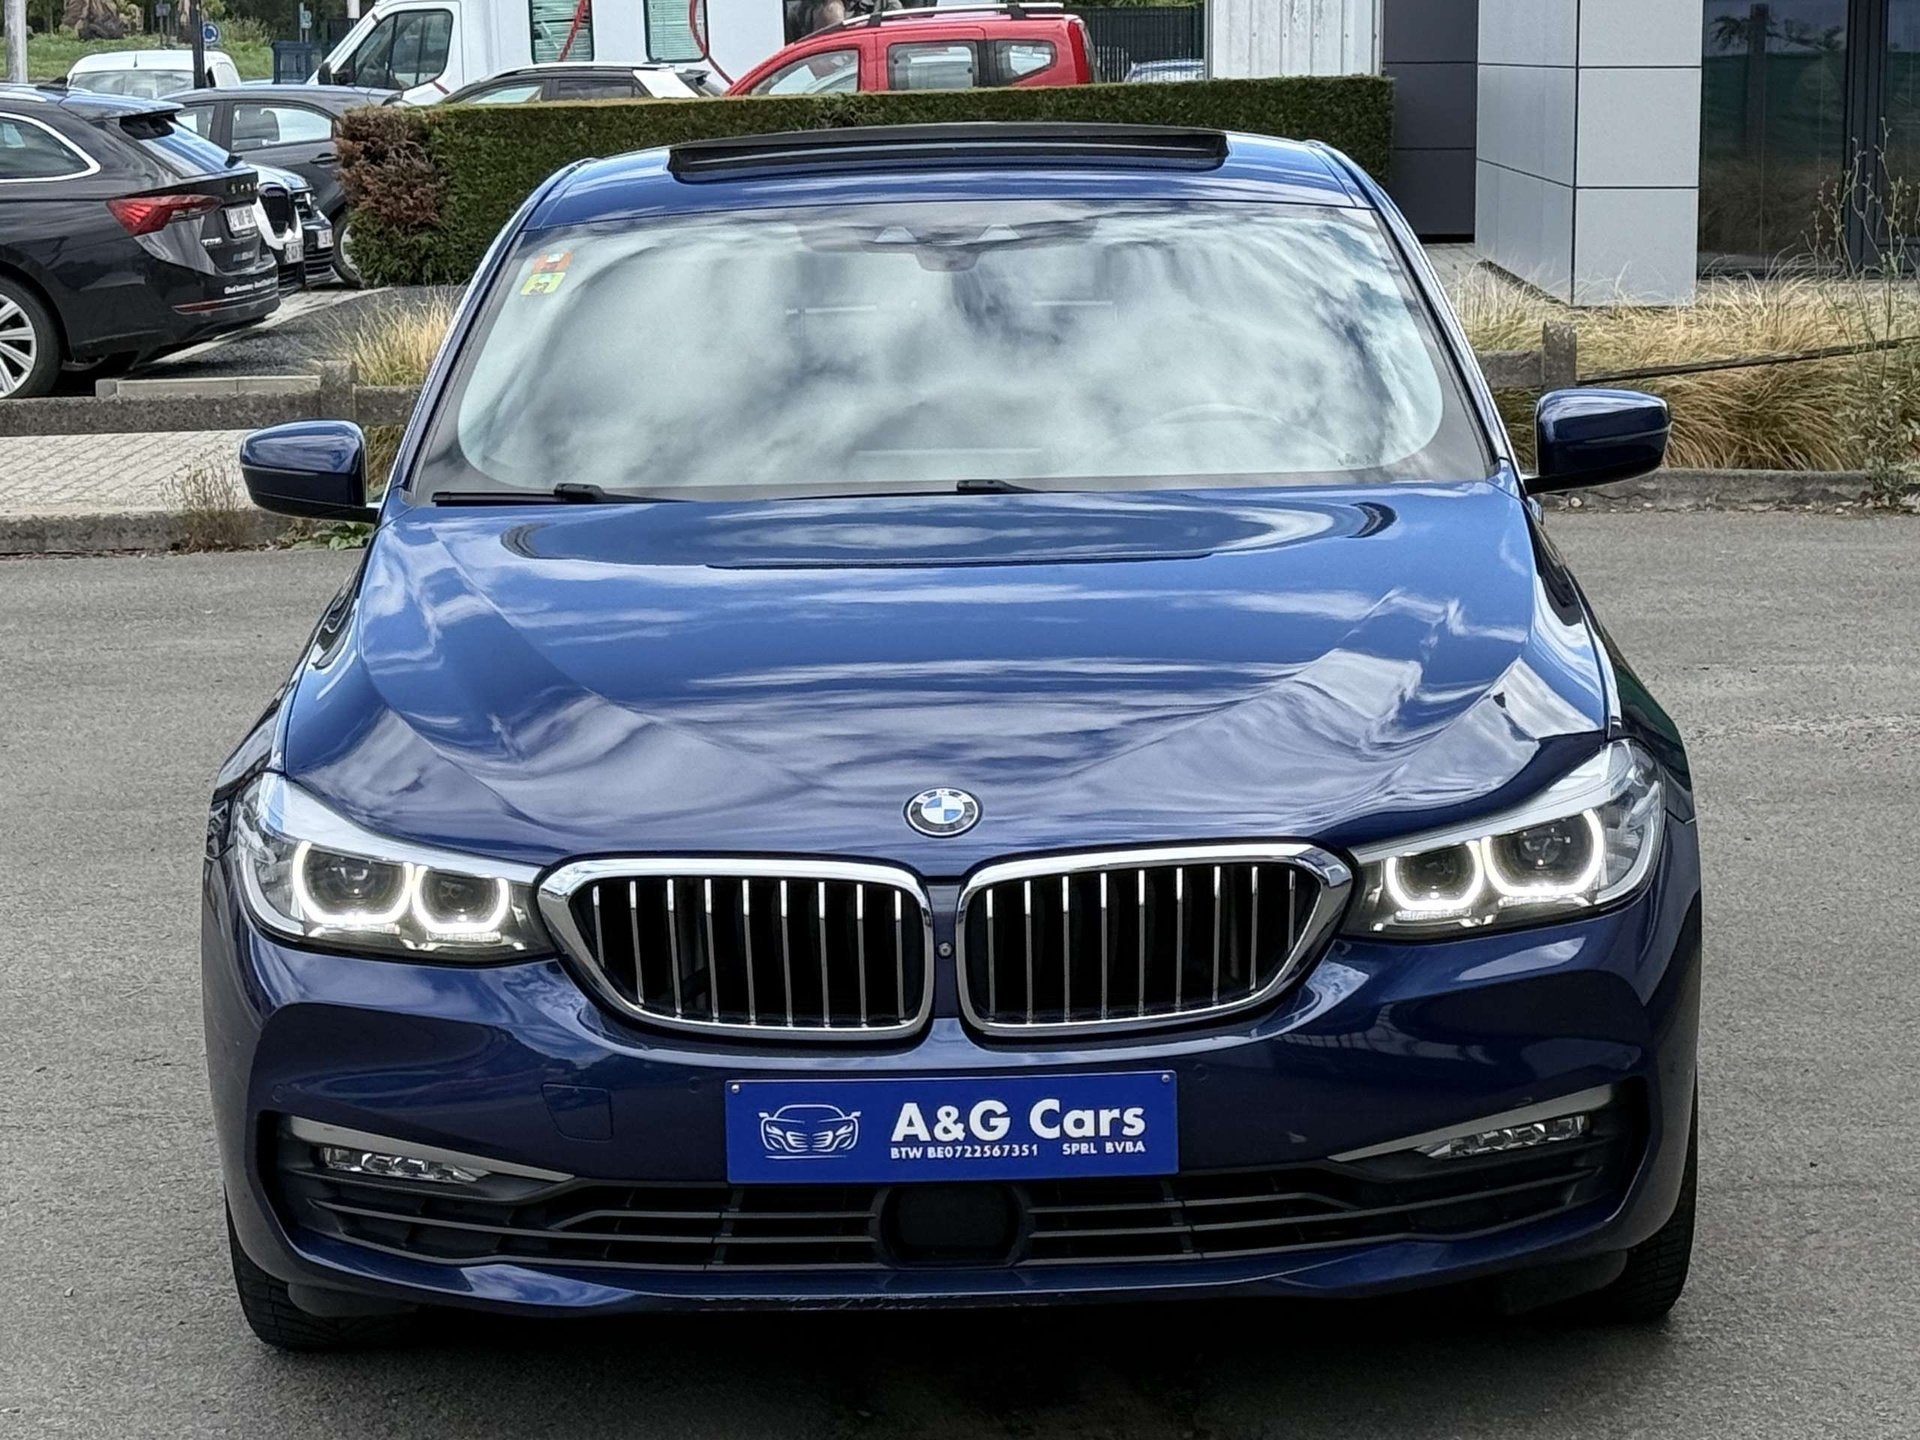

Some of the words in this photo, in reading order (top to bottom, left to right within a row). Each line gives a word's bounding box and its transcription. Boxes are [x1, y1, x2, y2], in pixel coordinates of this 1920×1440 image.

[891, 1099, 1011, 1142] A&G
[1029, 1098, 1146, 1140] Cars
[890, 1146, 923, 1159] BTW
[927, 1144, 1038, 1159] BE0722567351
[1062, 1142, 1097, 1155] SPRL
[1105, 1141, 1146, 1154] BVBA
